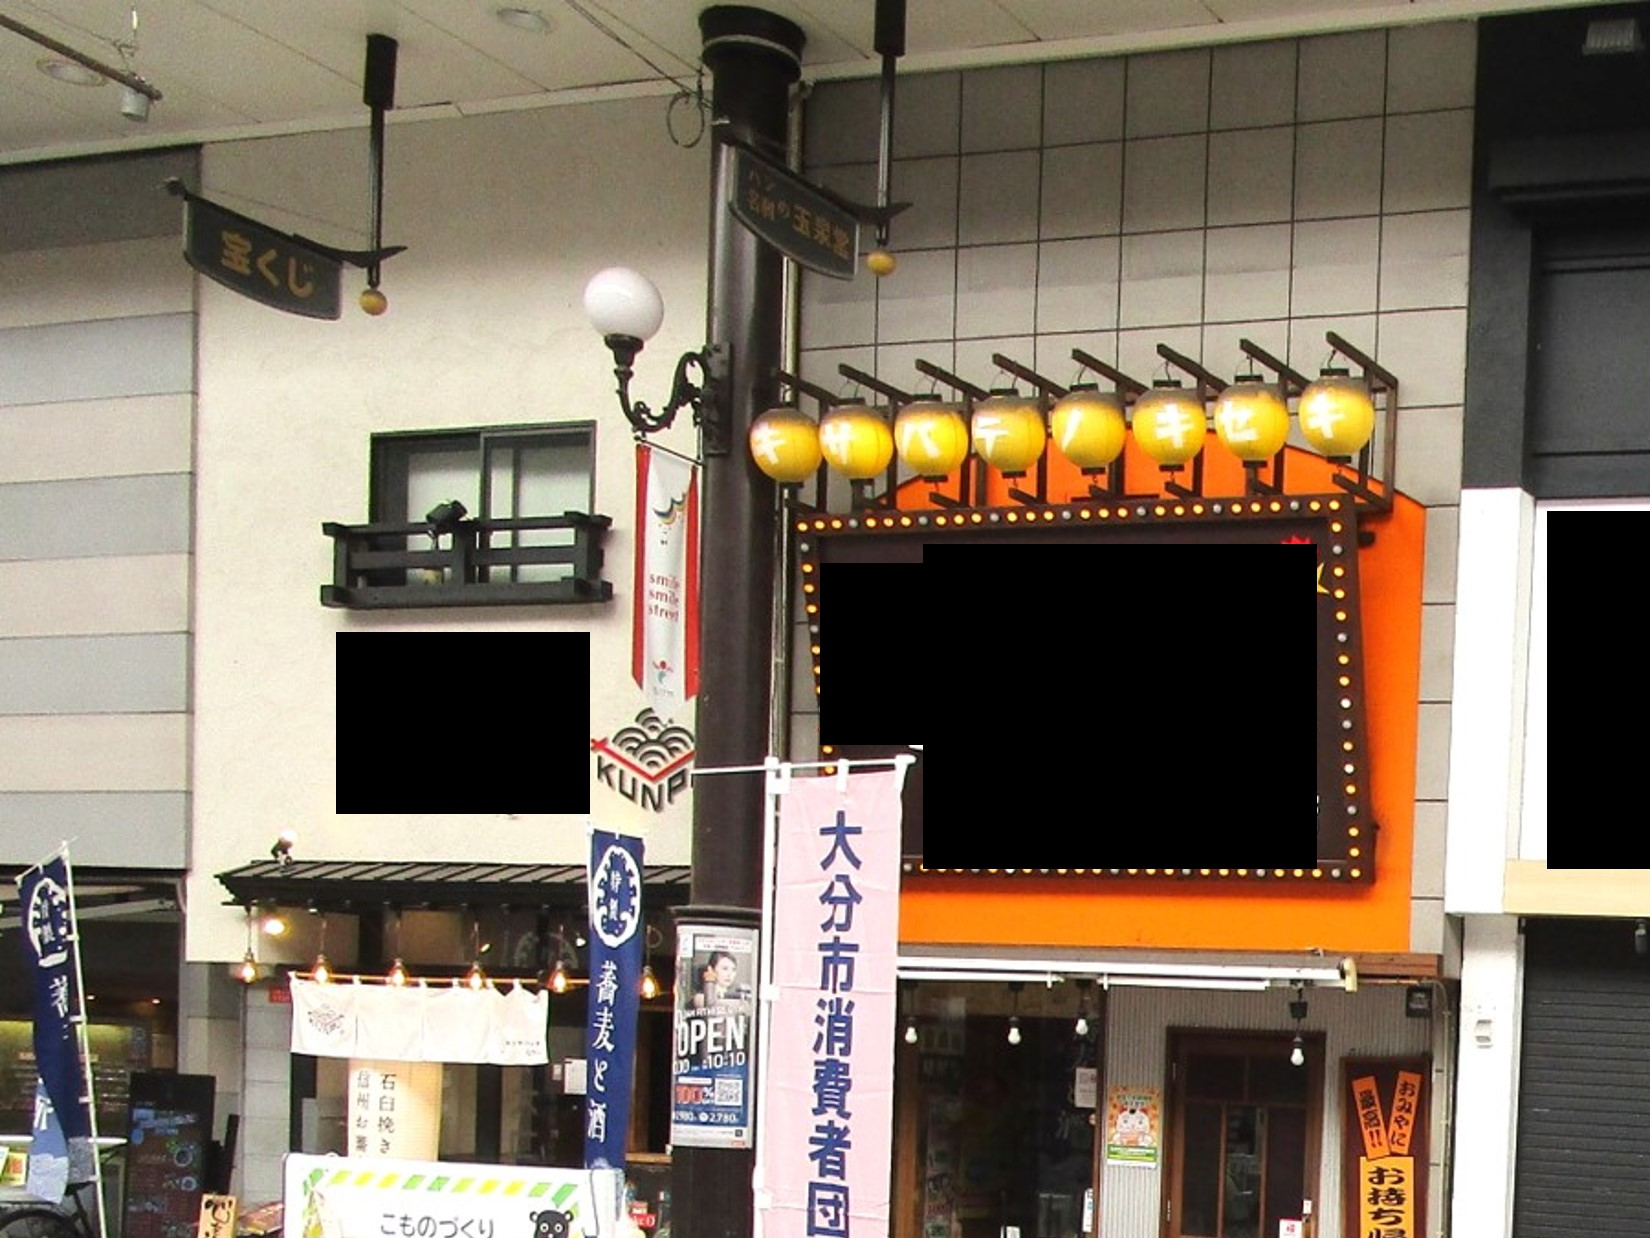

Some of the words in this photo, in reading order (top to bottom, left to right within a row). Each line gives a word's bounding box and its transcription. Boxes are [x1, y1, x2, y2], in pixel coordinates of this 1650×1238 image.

[220, 229, 315, 298] 宝くじ
[649, 573, 680, 588] smile
[649, 588, 680, 605] smile
[648, 604, 680, 622] street
[596, 755, 695, 813] KUNP
[587, 959, 619, 1144] 蕎麦と酒
[676, 1015, 745, 1057] OPEN
[1391, 1081, 1415, 1146] おみやに
